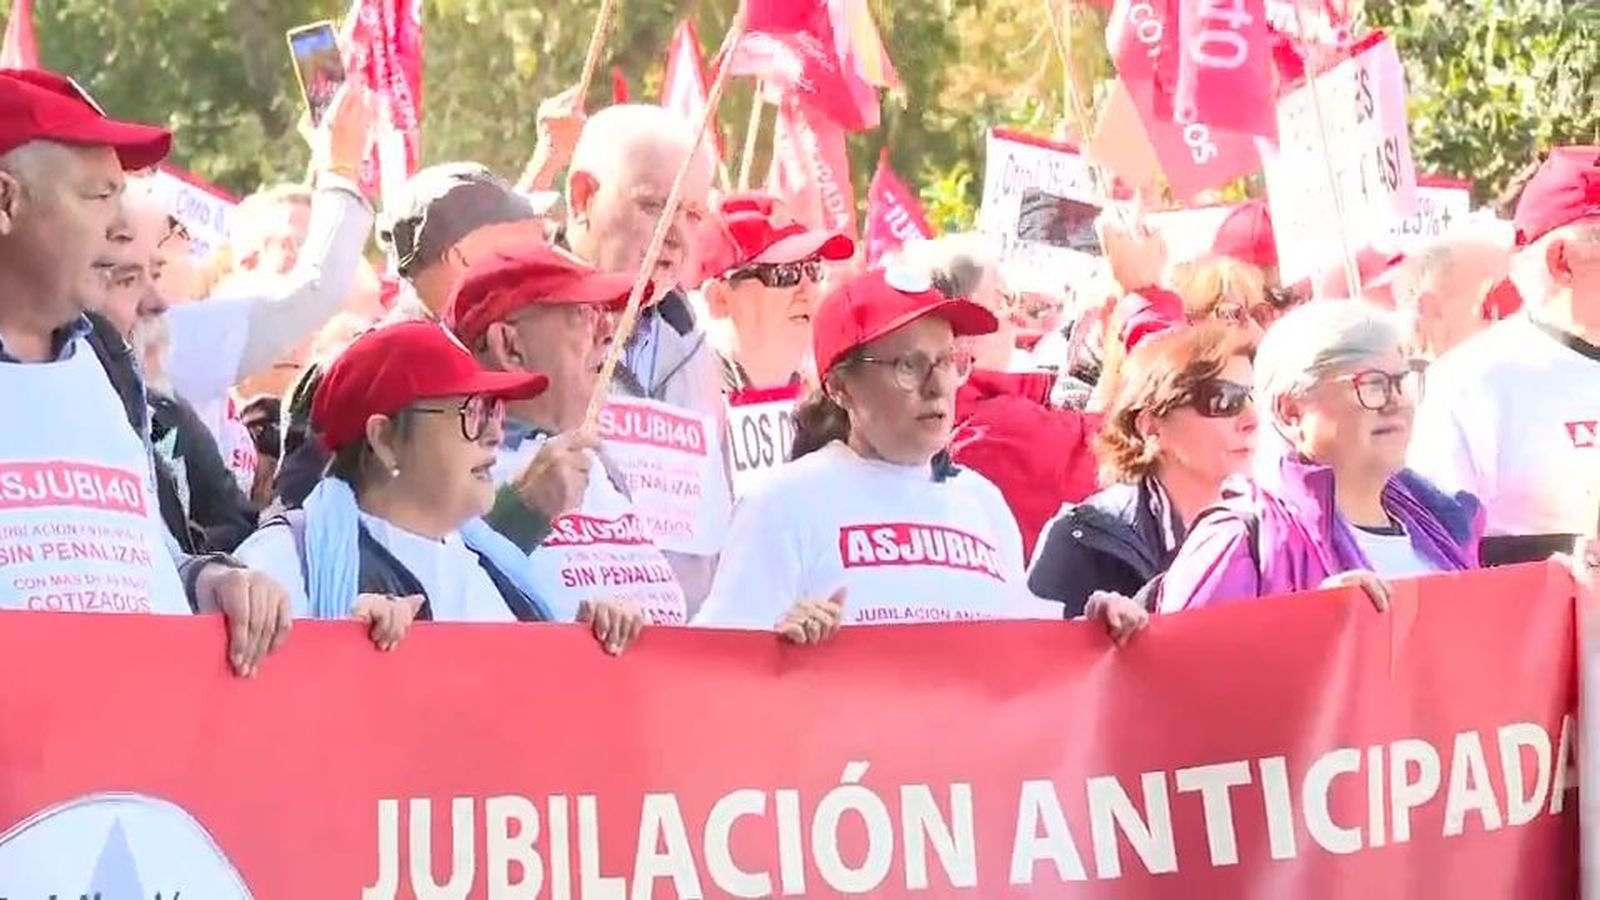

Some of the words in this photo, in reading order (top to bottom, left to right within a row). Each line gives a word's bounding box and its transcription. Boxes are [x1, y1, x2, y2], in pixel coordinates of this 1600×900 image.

[602, 409, 701, 447] SJUBI40
[728, 412, 774, 472] LOS
[0, 468, 142, 507] SJUBI40
[561, 565, 598, 588] SIN
[855, 607, 951, 623] JUBILACION
[362, 760, 978, 900] JUBILACIÓN
